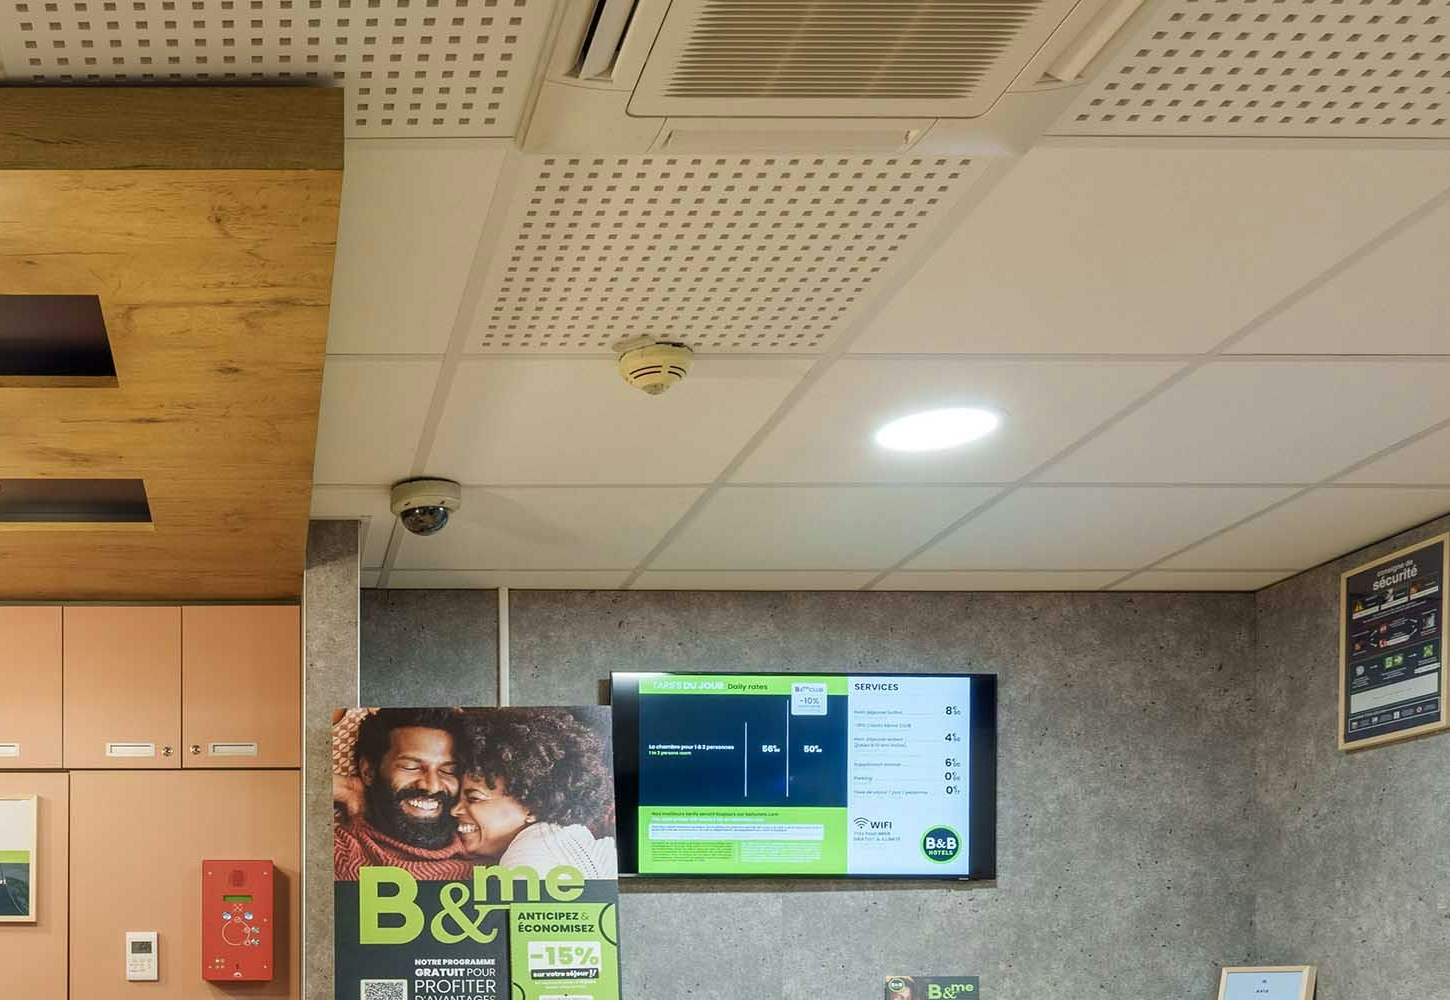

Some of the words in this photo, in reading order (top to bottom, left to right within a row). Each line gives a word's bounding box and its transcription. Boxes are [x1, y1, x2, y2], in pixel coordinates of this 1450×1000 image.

[1373, 564, 1417, 590] sécurité
[854, 683, 899, 691] SERVICES
[870, 821, 892, 829] WIFI
[926, 837, 957, 849] B&B
[359, 864, 585, 945] B&me
[518, 912, 579, 920] ANTICIPEZ
[581, 912, 589, 920] &
[518, 922, 595, 933] ÉCONOMISEZ
[530, 946, 599, 966] -15%
[415, 968, 466, 977] GRATUIT
[467, 968, 496, 976] POUR
[415, 979, 496, 993] PROFITER
[928, 983, 974, 999] B&me
